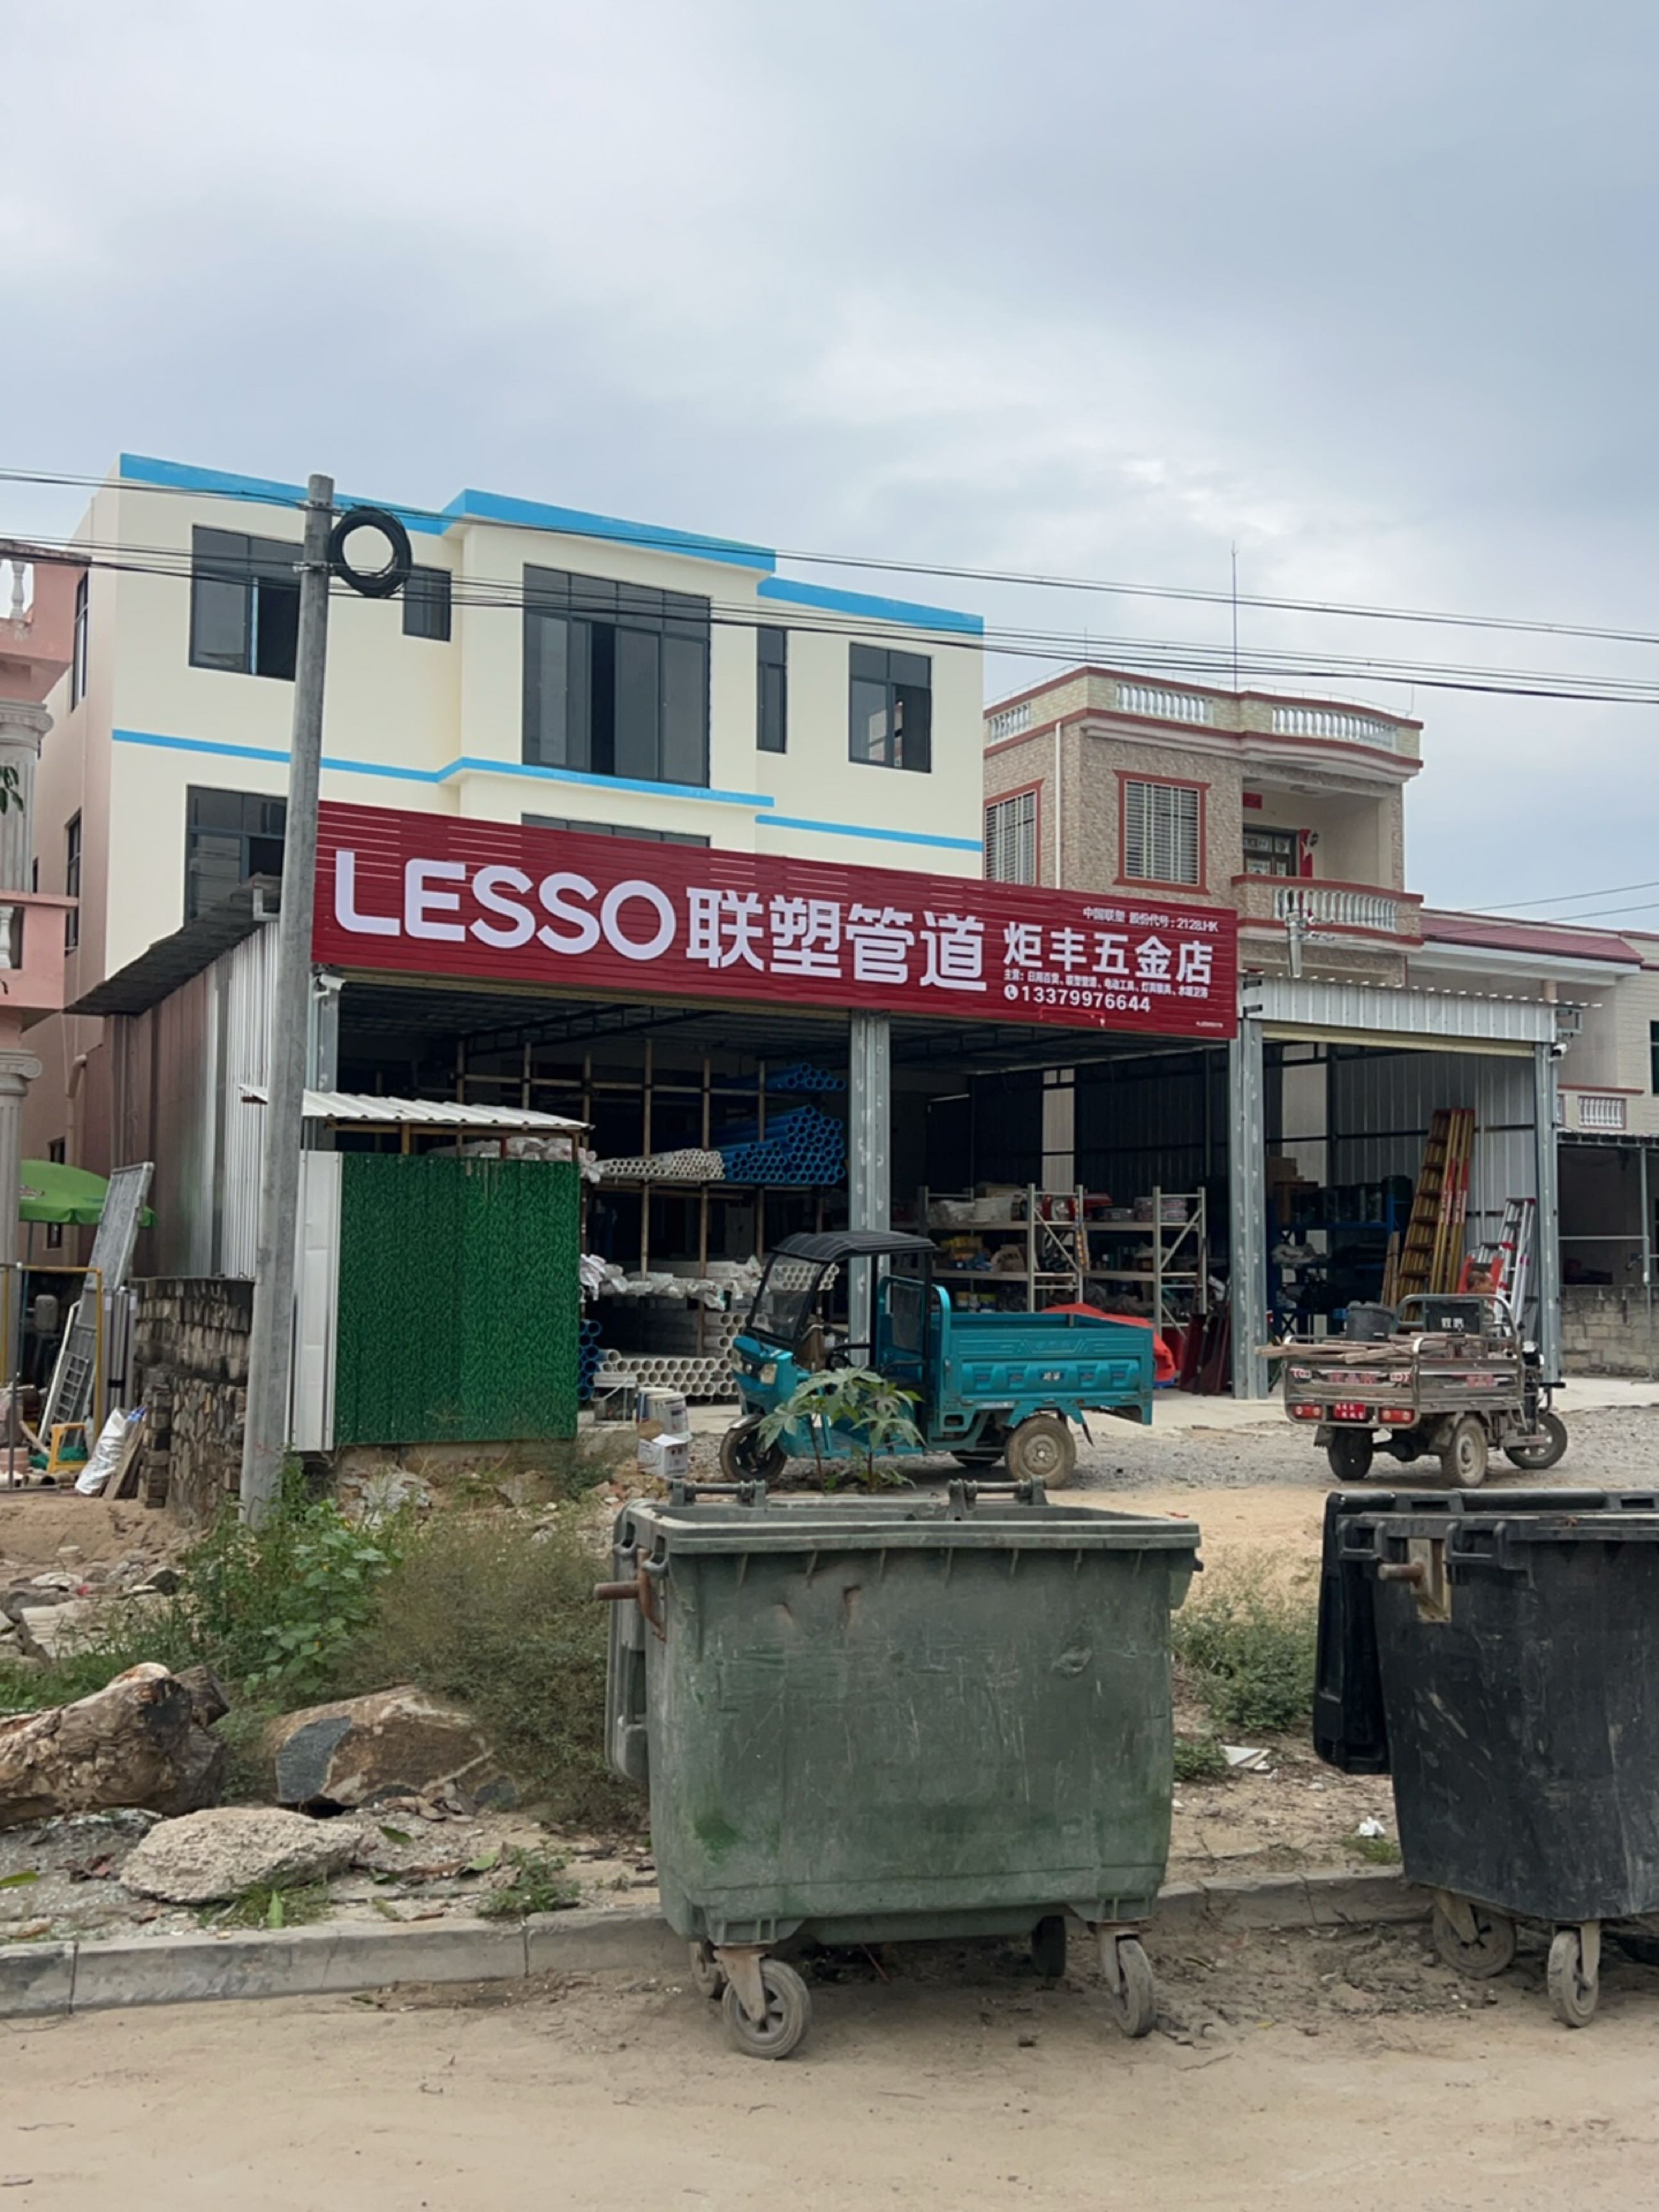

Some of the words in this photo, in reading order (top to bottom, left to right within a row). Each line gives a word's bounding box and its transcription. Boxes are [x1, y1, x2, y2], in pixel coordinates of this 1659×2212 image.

[335, 851, 677, 960] LESSO
[686, 886, 987, 991] 联塑管道
[1003, 920, 1213, 986] 炬丰五金店
[1022, 985, 1151, 1013] 13379976644
